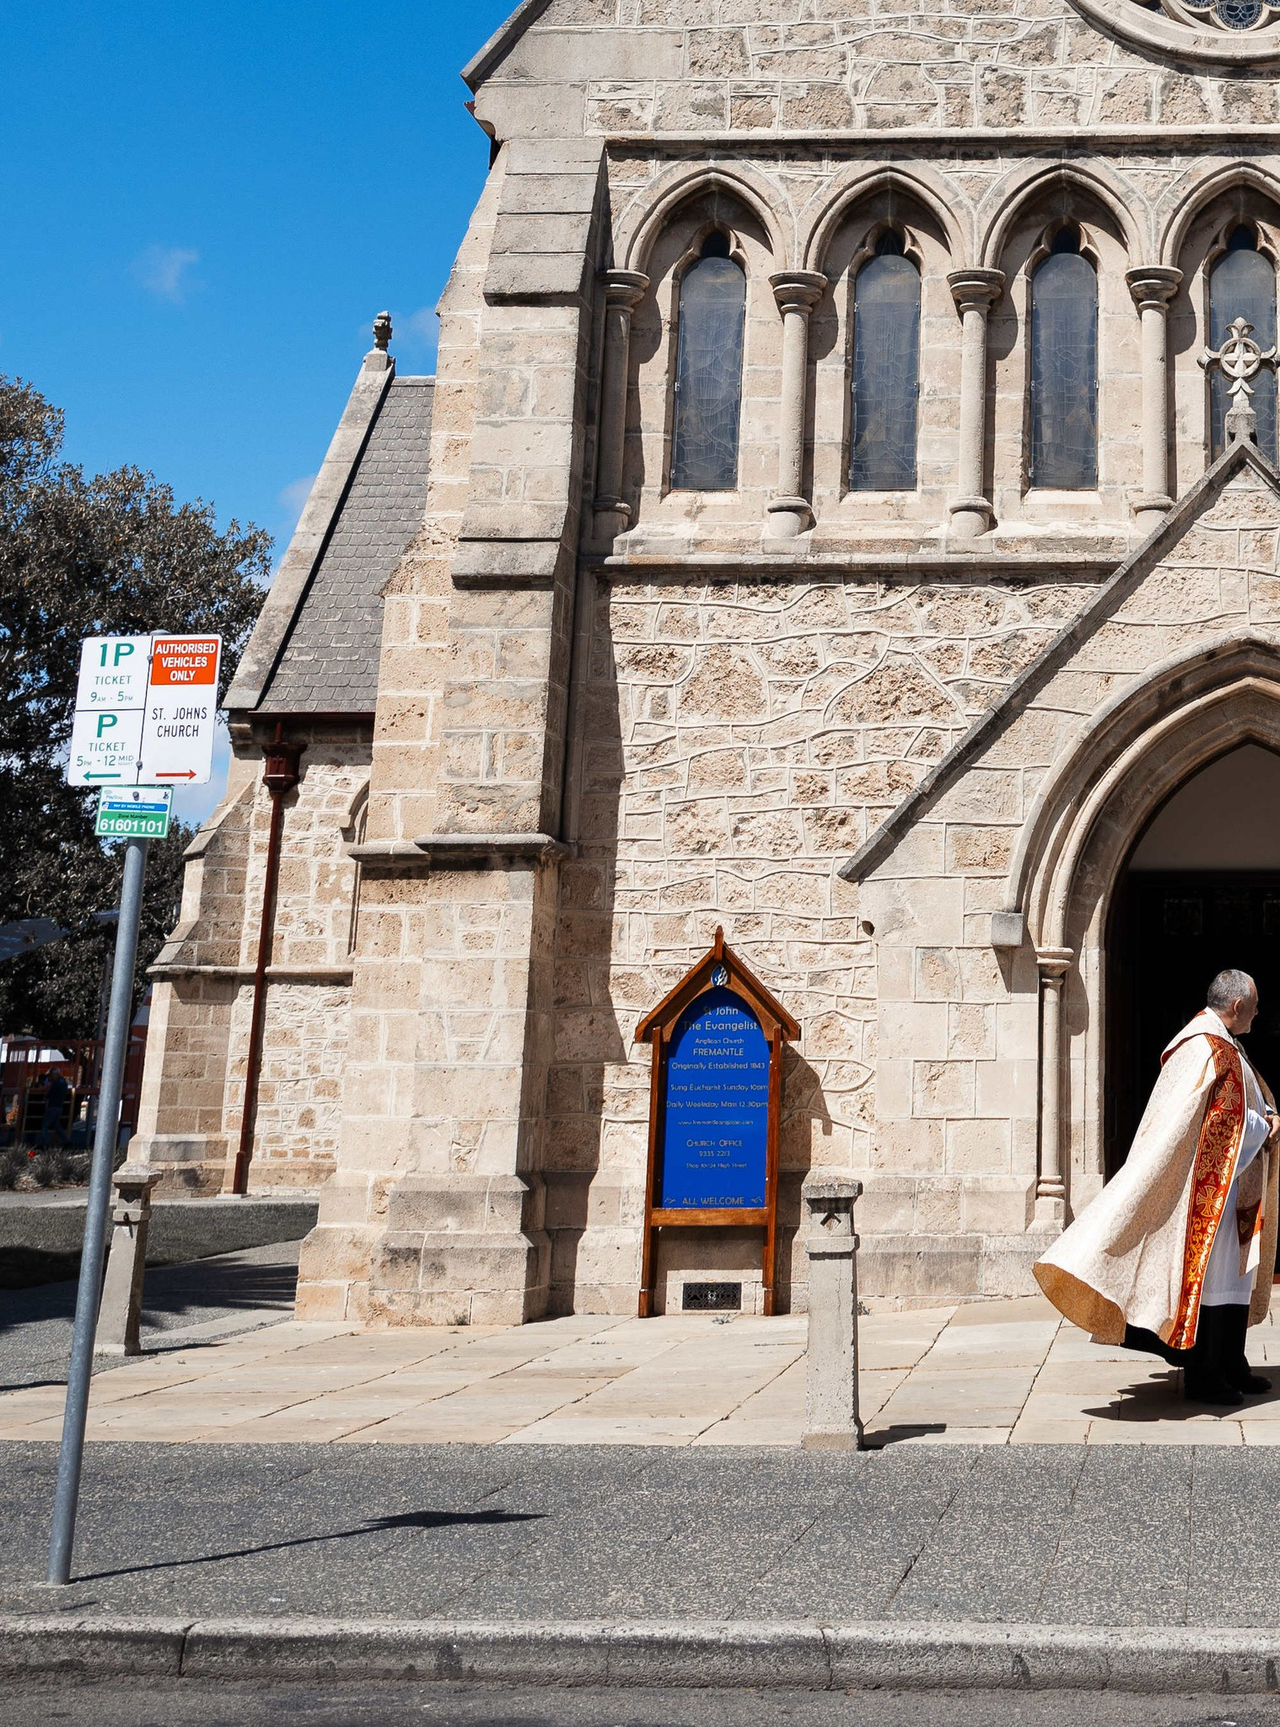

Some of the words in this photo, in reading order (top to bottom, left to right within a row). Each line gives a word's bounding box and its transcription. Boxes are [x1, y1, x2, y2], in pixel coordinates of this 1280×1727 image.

[155, 643, 216, 654] AUTHORISED
[100, 642, 135, 667] 1P
[161, 656, 208, 668] VEHICLES
[95, 675, 132, 685] TICKET
[169, 670, 196, 681] ONLY
[152, 707, 166, 720] ST.
[172, 707, 208, 720] JOHNS
[96, 714, 118, 738] P
[157, 724, 200, 738] CHURCH
[88, 742, 126, 752] TICKET
[100, 818, 163, 833] 61601101
[715, 1005, 739, 1016] John
[683, 1021, 701, 1030] The
[705, 1020, 757, 1032] Evangelist
[695, 1037, 721, 1045] Anglican
[693, 1047, 744, 1056] FREMANTLE
[671, 1062, 706, 1070] Originally
[689, 1083, 720, 1091] Eucharist
[723, 1083, 749, 1091] Sunday
[682, 1196, 698, 1205] ALL
[700, 1196, 744, 1205] WELCOME
